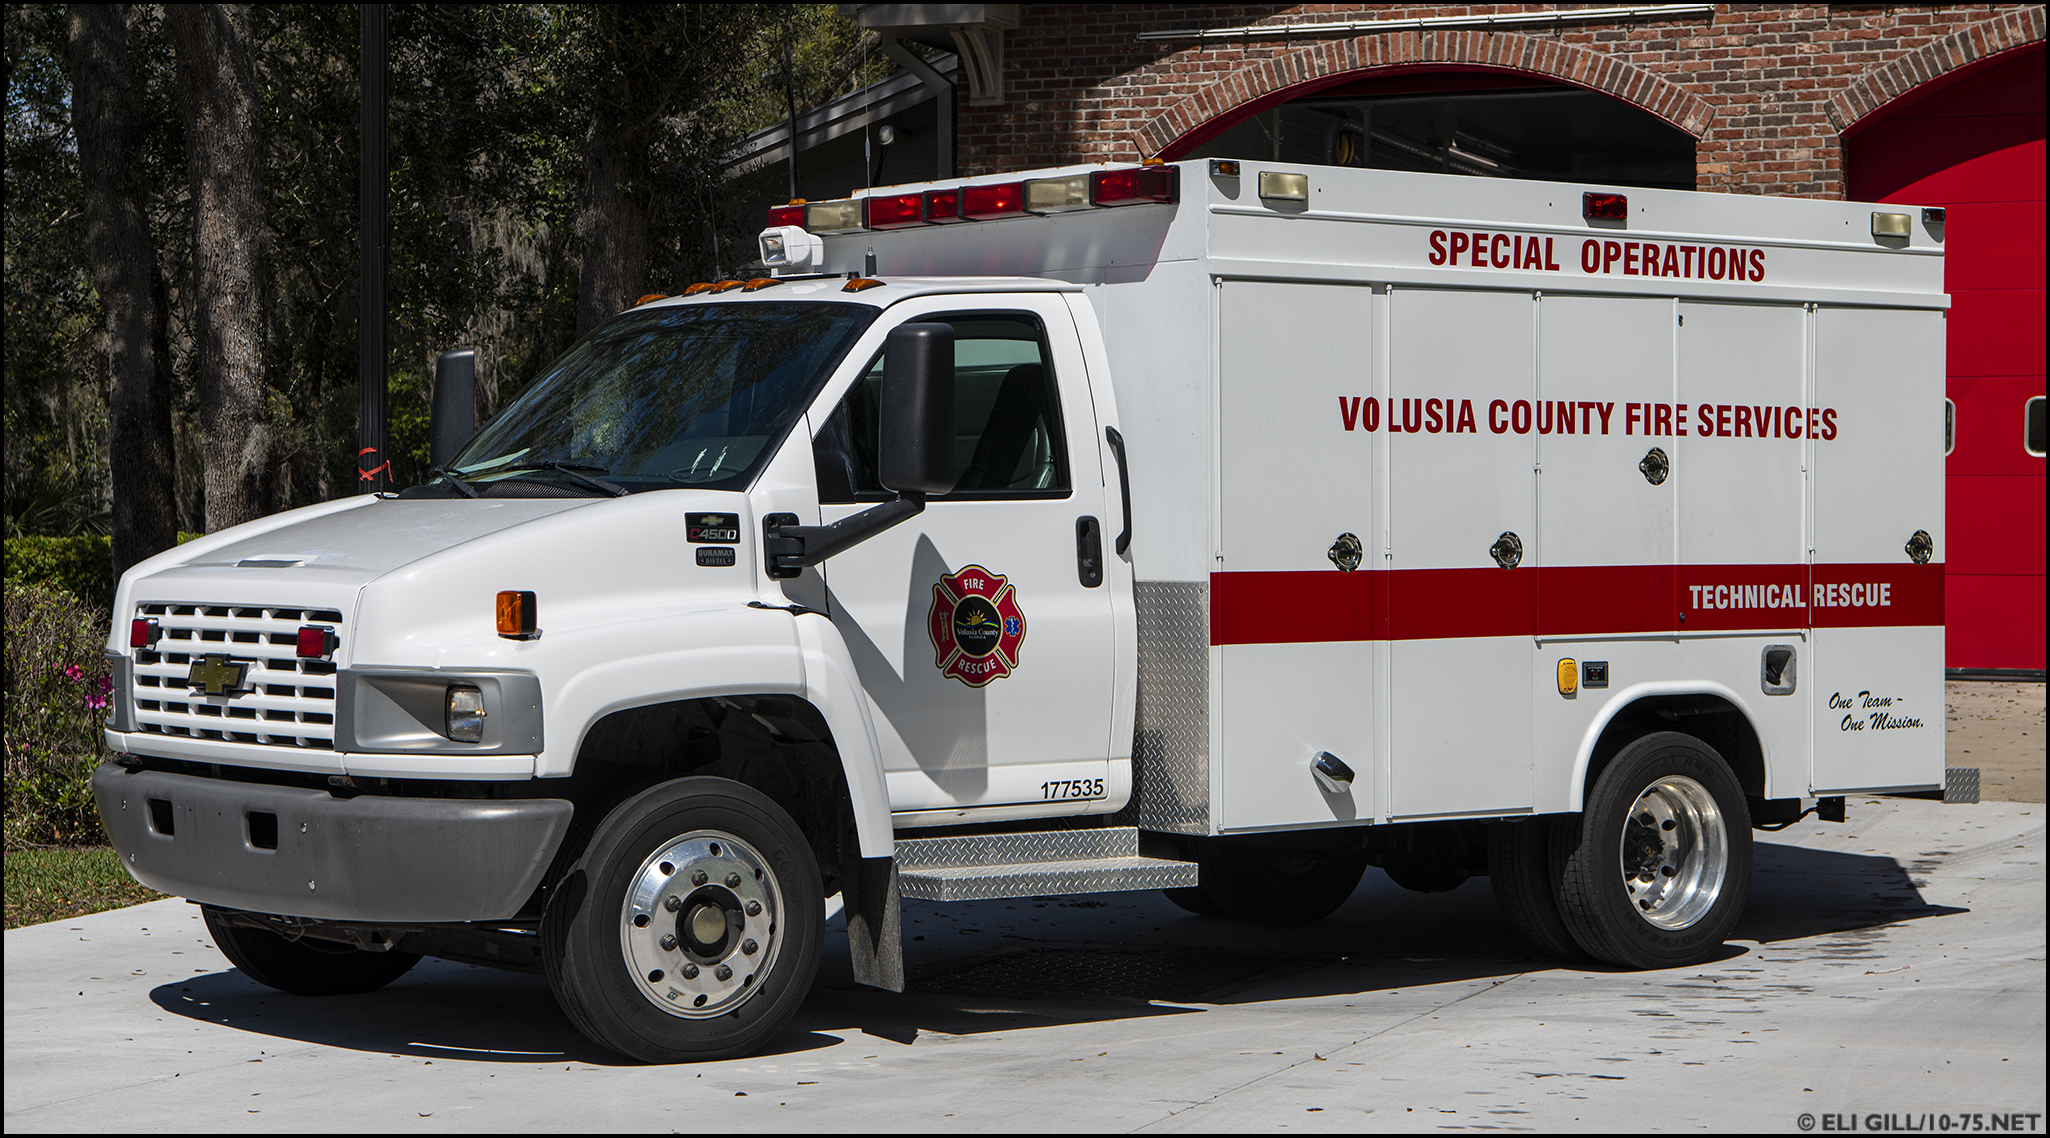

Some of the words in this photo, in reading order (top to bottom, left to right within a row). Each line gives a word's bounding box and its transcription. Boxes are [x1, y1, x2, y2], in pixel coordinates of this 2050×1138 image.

[1428, 229, 1560, 272] SPECIAL
[1580, 238, 1766, 283] OPERATIONS
[1338, 396, 1478, 434] VOLUSIA
[1488, 399, 1616, 436] COUNTY
[1625, 402, 1688, 437] FIRE
[1697, 403, 1838, 441] SERVICES
[690, 528, 737, 539] C4500
[697, 549, 733, 557] DURAMAX
[963, 578, 985, 590] FIRE
[1689, 584, 1807, 610] TECHNICAL
[1813, 583, 1891, 607] RESCUE
[957, 628, 978, 637] Volusia
[978, 628, 999, 637] County
[958, 658, 997, 674] RESCUE
[1828, 691, 1853, 709] One
[1858, 690, 1893, 709] Team
[1841, 713, 1865, 731] One
[1869, 712, 1924, 731] Mission.
[1040, 778, 1104, 799] 177535
